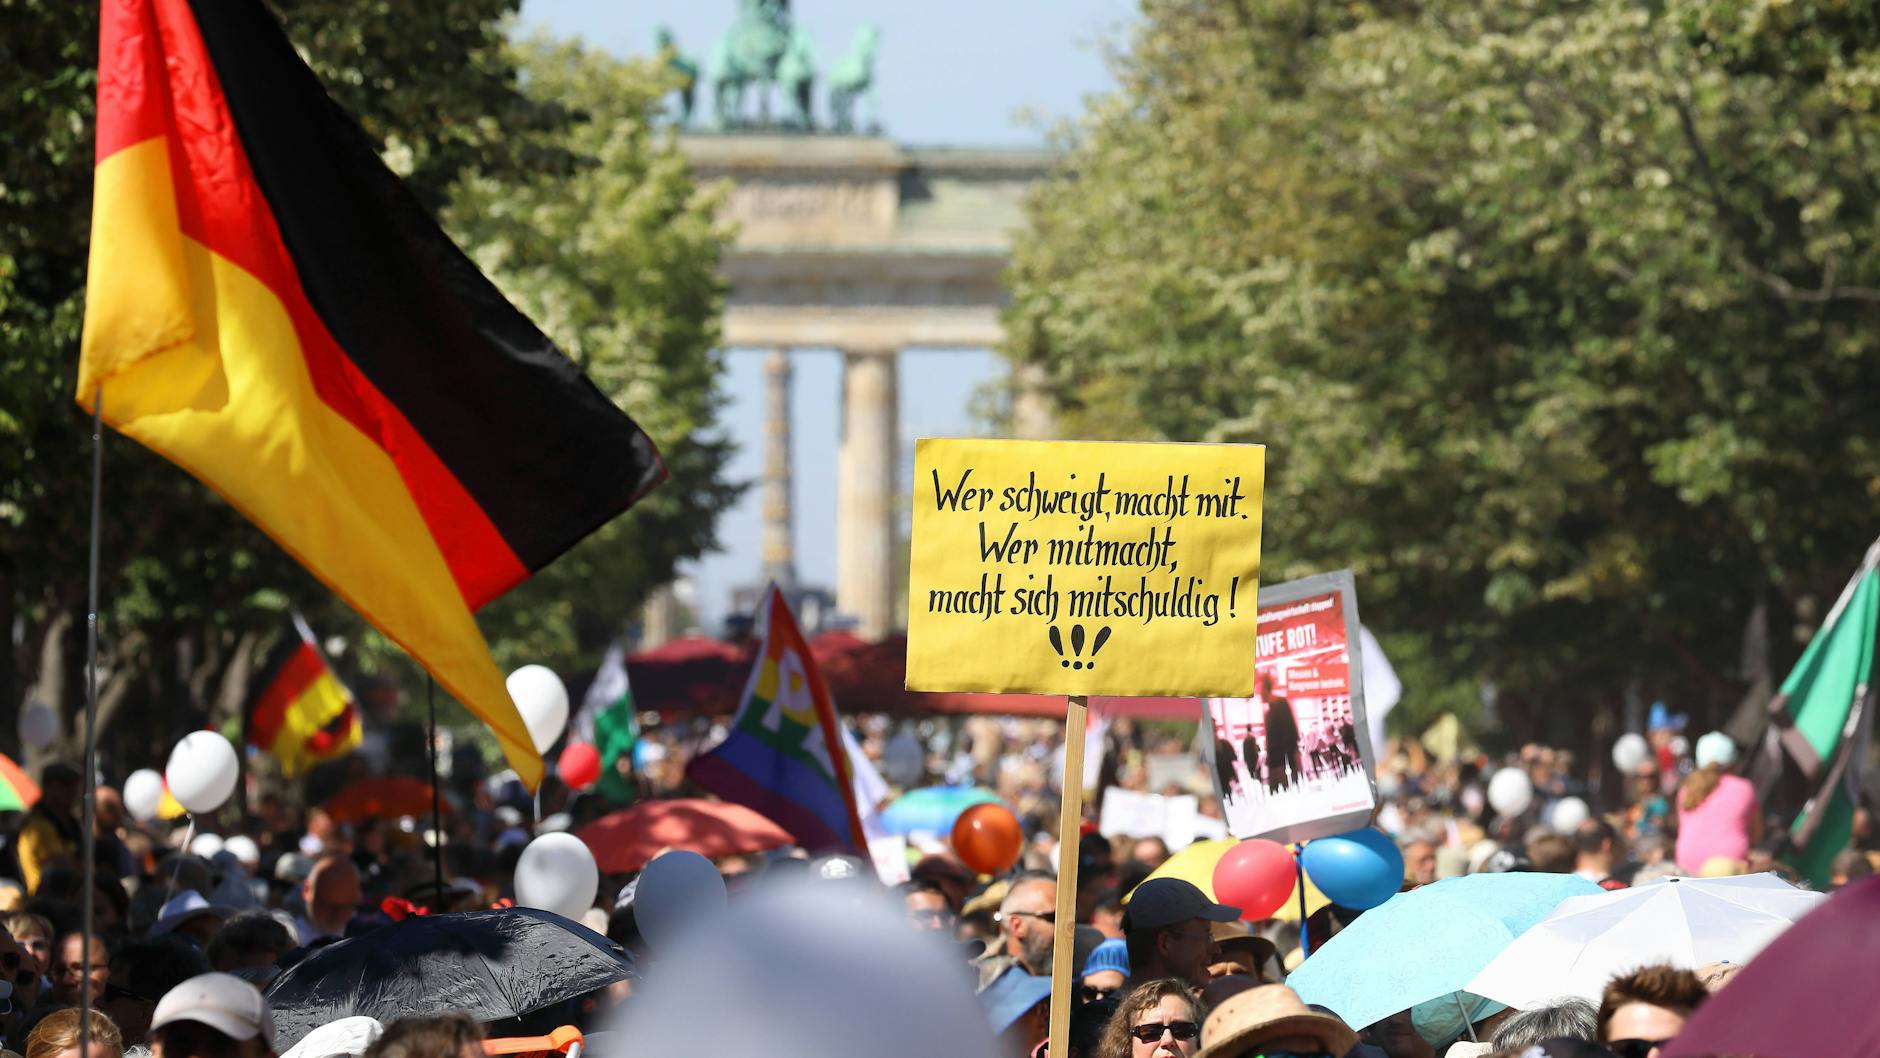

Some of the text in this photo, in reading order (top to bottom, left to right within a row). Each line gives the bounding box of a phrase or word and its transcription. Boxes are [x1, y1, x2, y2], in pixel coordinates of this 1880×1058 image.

[932, 468, 1248, 524] Wer schweigt, macht mit.
[980, 522, 1178, 574] Wer mitmacht,
[929, 572, 1006, 622] macht
[1010, 574, 1059, 624] sich
[1067, 575, 1220, 627] mitschuldig
[1286, 623, 1316, 650] ROT!
